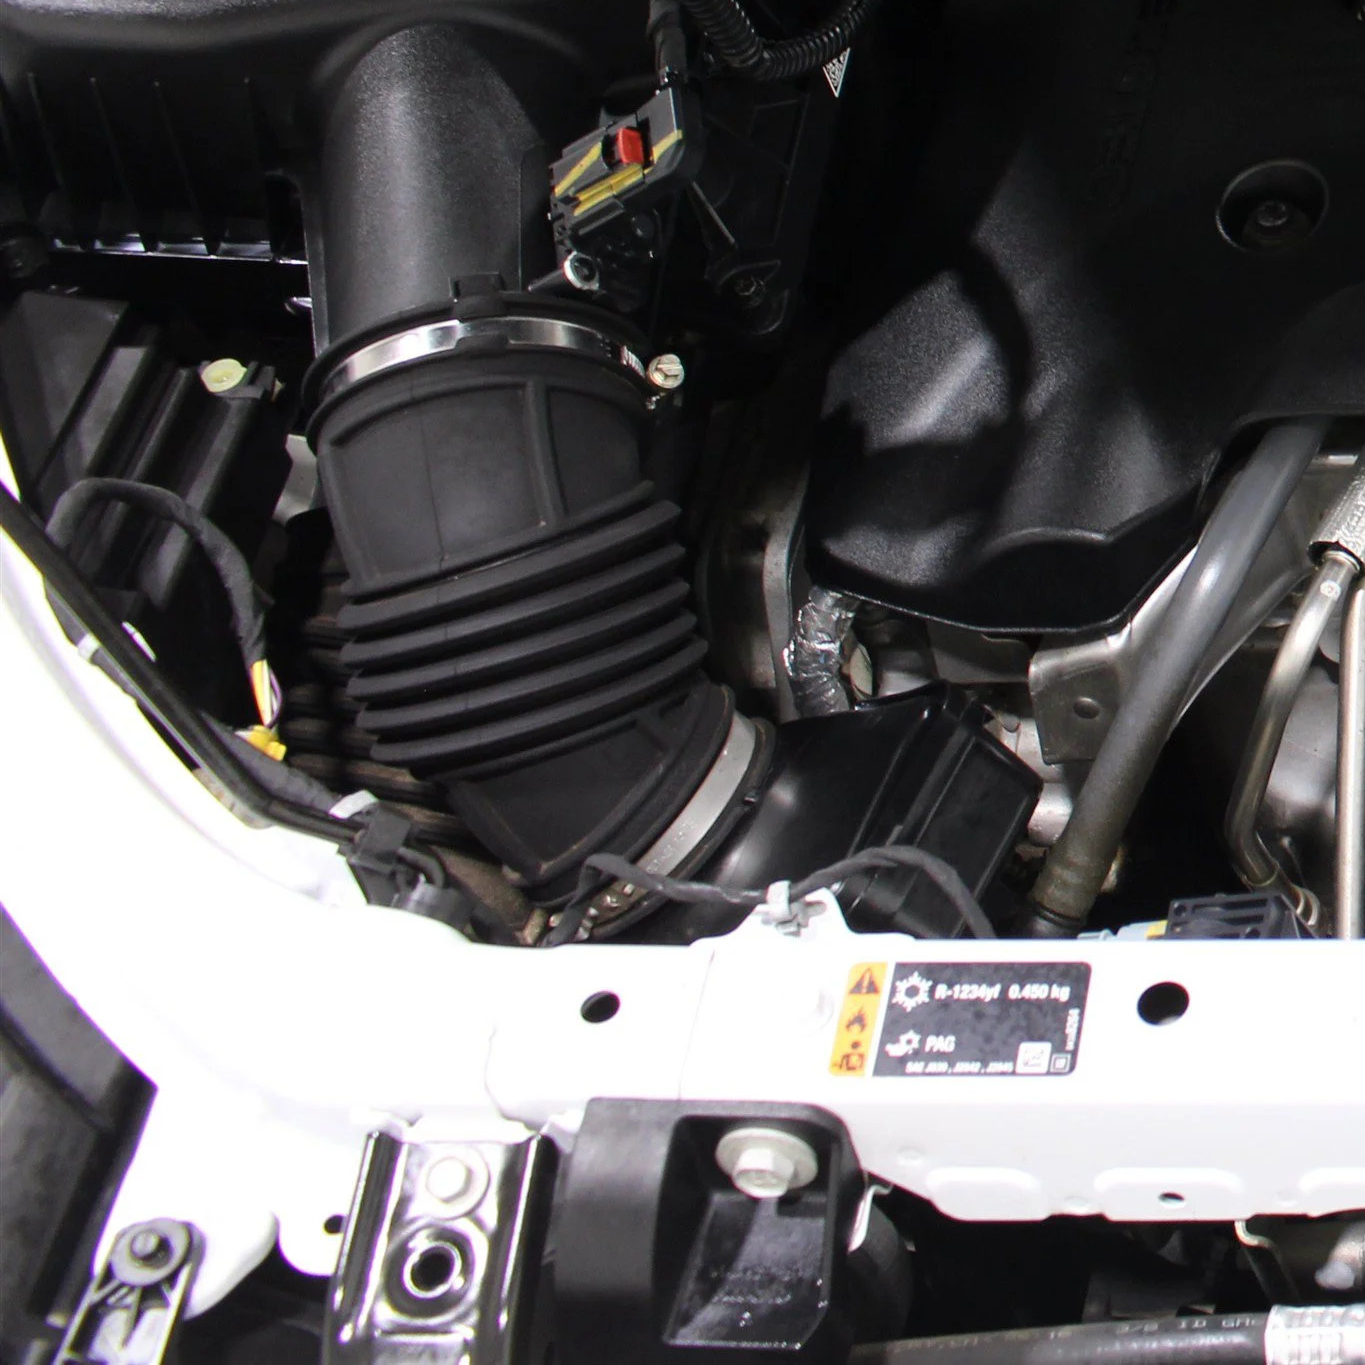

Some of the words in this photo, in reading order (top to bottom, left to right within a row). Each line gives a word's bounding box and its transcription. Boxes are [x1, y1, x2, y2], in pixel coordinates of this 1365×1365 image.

[935, 984, 1002, 1003] R-1234yf
[1008, 984, 1050, 1000] 0.450
[1051, 985, 1071, 1003] kg
[925, 1035, 956, 1053] PAG
